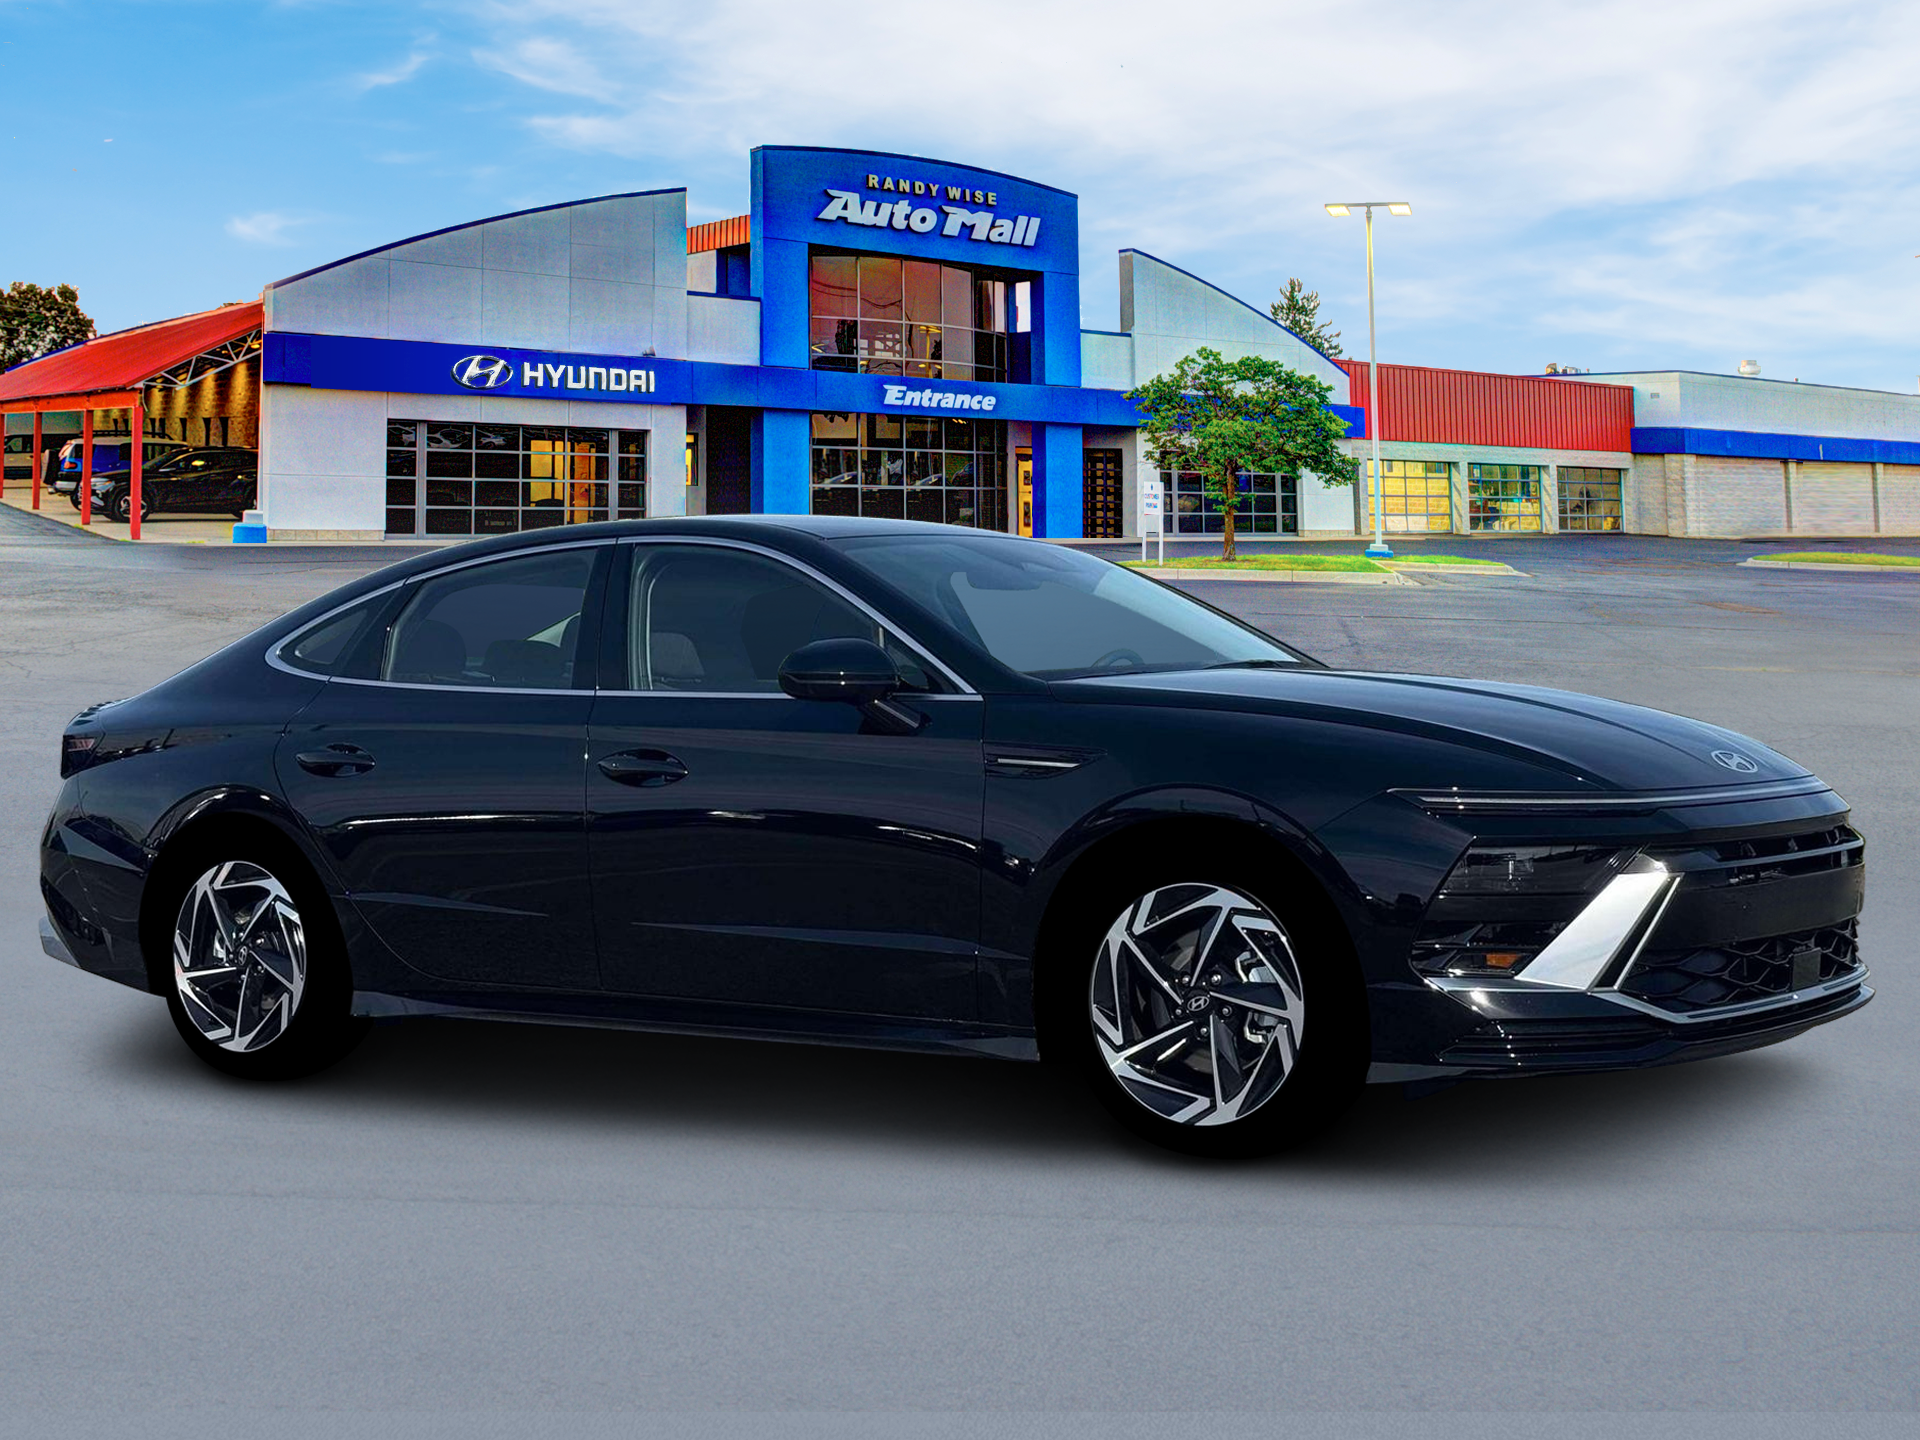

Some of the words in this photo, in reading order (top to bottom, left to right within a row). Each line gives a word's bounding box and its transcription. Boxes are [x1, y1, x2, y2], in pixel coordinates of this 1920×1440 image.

[866, 174, 940, 197] RANDY
[946, 186, 998, 206] WISE
[816, 188, 938, 233] Auto
[940, 204, 1042, 247] Mall
[521, 361, 656, 393] HYUNDAI
[882, 384, 997, 411] Entrance
